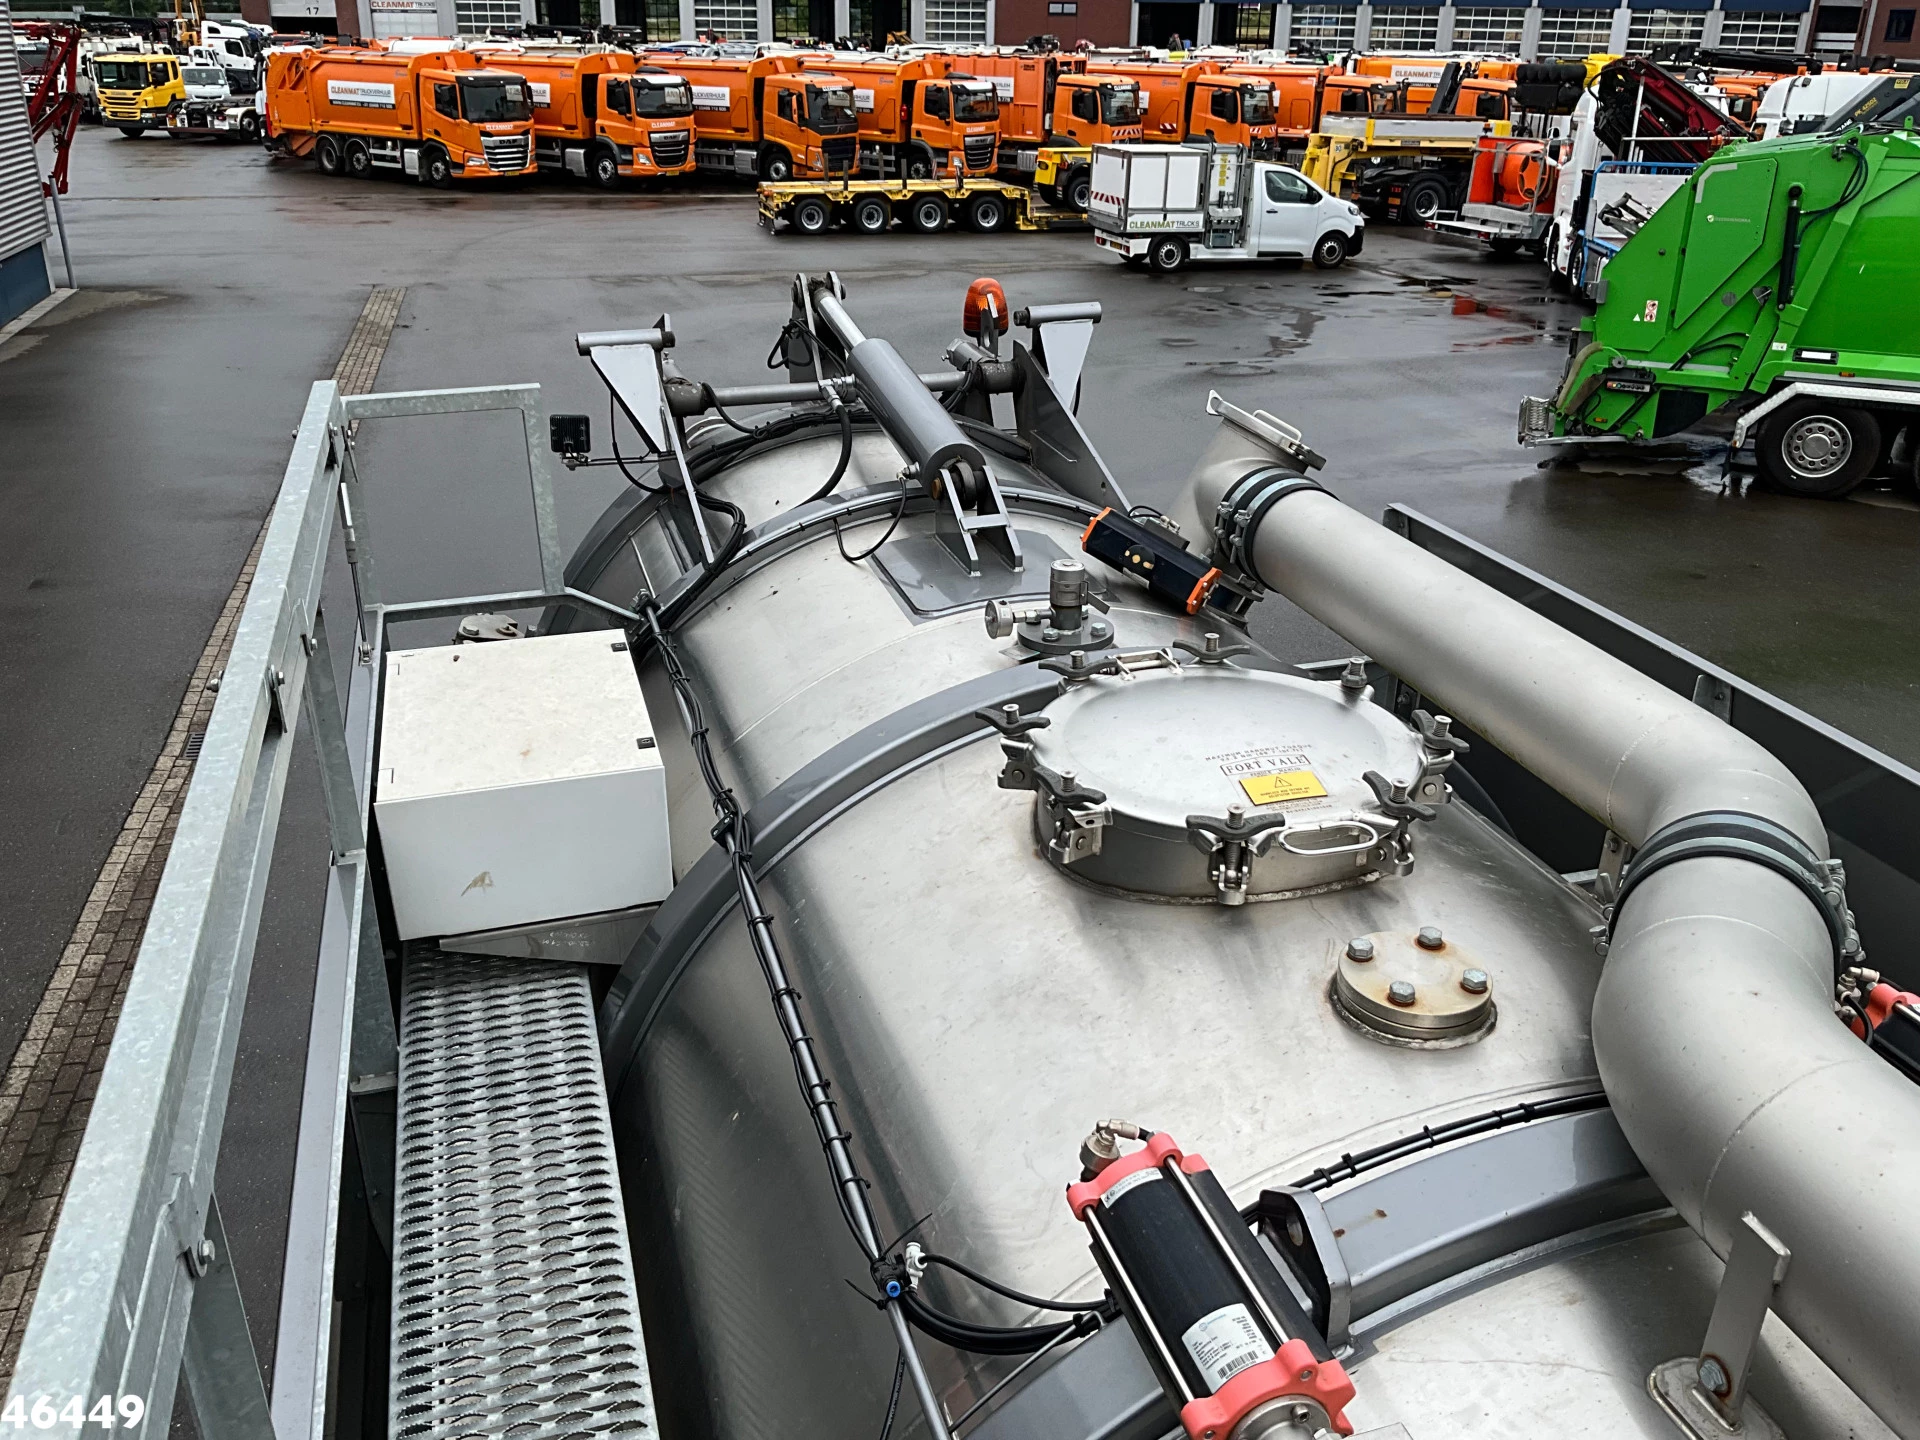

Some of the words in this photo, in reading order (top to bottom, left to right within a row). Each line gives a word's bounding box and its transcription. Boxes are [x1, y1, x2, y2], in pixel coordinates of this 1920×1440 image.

[331, 86, 359, 95] CLEANMAT
[1129, 220, 1175, 229] CLEANMAT
[1226, 760, 1262, 774] FORT
[1267, 755, 1306, 767] VALE
